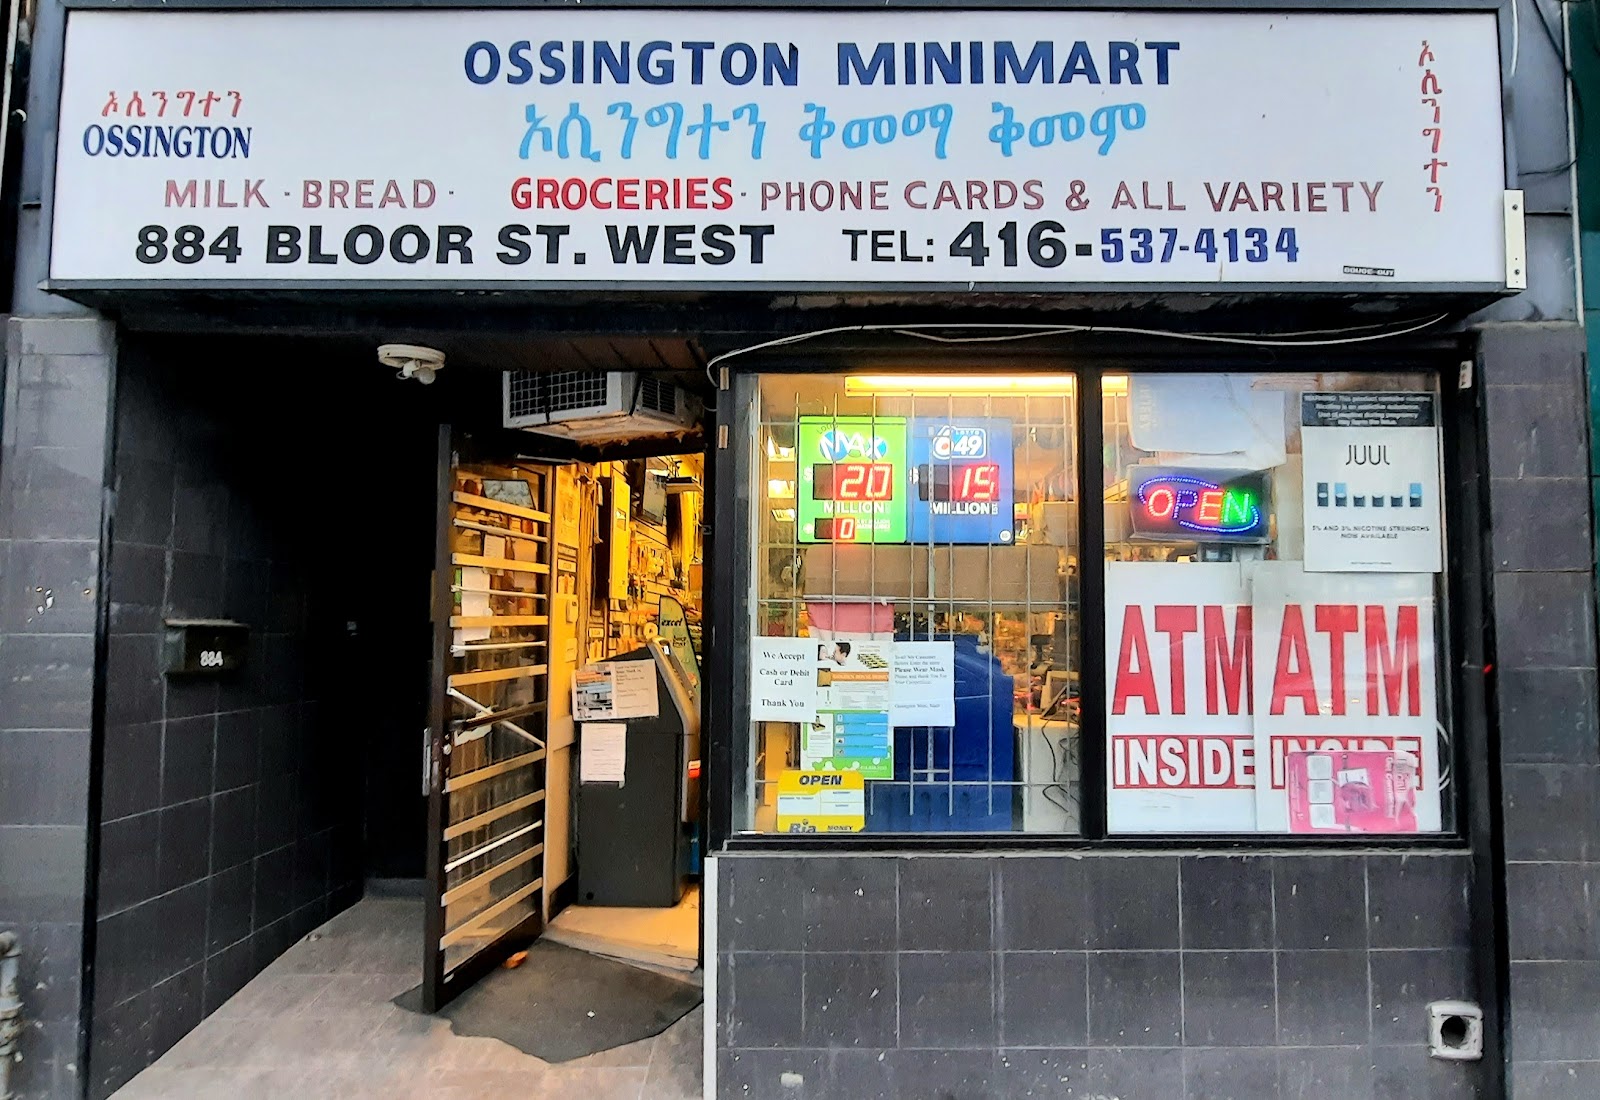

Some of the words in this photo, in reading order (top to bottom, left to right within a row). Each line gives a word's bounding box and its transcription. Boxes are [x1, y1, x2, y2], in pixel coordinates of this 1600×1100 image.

[464, 40, 799, 86] OSSINGTON
[837, 40, 1180, 86] MINIMART
[83, 124, 252, 159] OSSINGTON
[164, 179, 270, 208] MILK
[302, 179, 436, 209] BREAD
[511, 177, 733, 211] GROCERIES
[761, 181, 889, 211] PHONE
[903, 180, 1044, 211] CARDS
[1065, 179, 1090, 211] &
[1111, 181, 1187, 210] ALL
[1203, 181, 1385, 212] VARIETY
[136, 225, 242, 264] 884
[266, 224, 473, 265] BLOOR
[496, 224, 586, 265] ST.
[605, 224, 775, 265] WEST
[842, 229, 934, 262] TEL:
[820, 430, 887, 461] MAX
[1345, 444, 1391, 466] JUUL
[840, 465, 891, 499] 20
[823, 502, 885, 515] MILLION
[929, 502, 990, 515] MILLION
[1148, 488, 1250, 523] OPEN
[759, 668, 778, 676] Cash
[790, 669, 810, 677] Debit
[763, 651, 777, 660] We
[778, 652, 805, 662] Accept
[1111, 604, 1254, 716] ATM
[1269, 604, 1422, 716] ATM
[761, 698, 787, 707] Thank
[789, 699, 805, 708] You
[1114, 738, 1255, 787] INSIDE
[799, 774, 842, 786] OPEN
